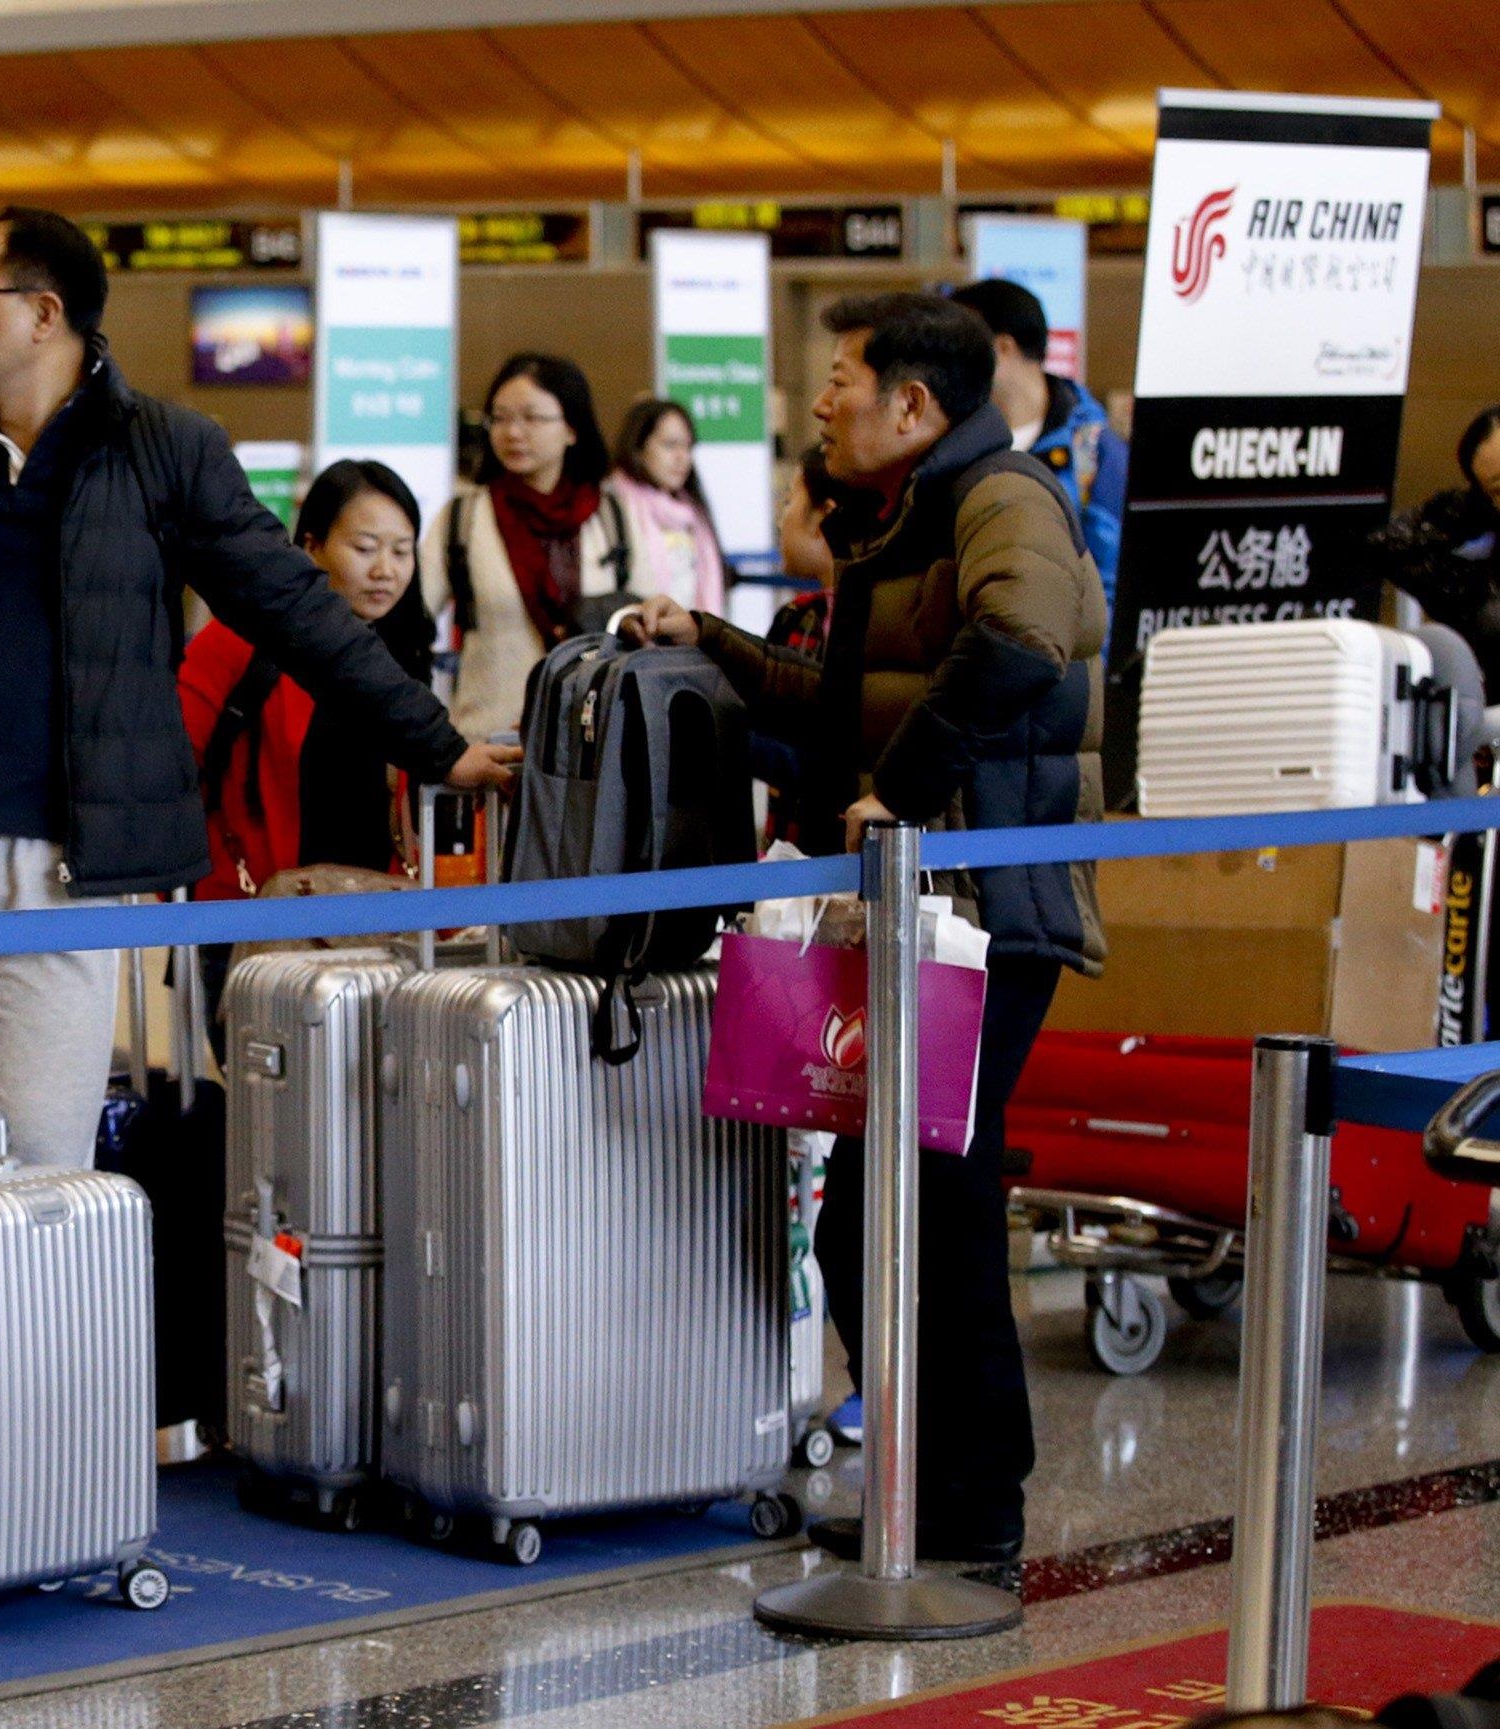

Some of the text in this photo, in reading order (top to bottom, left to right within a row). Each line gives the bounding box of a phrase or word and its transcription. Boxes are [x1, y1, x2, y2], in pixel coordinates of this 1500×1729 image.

[1248, 199, 1404, 241] AIR CHINA
[1191, 426, 1344, 479] CHECK-IN
[1198, 524, 1312, 590] 公务舱
